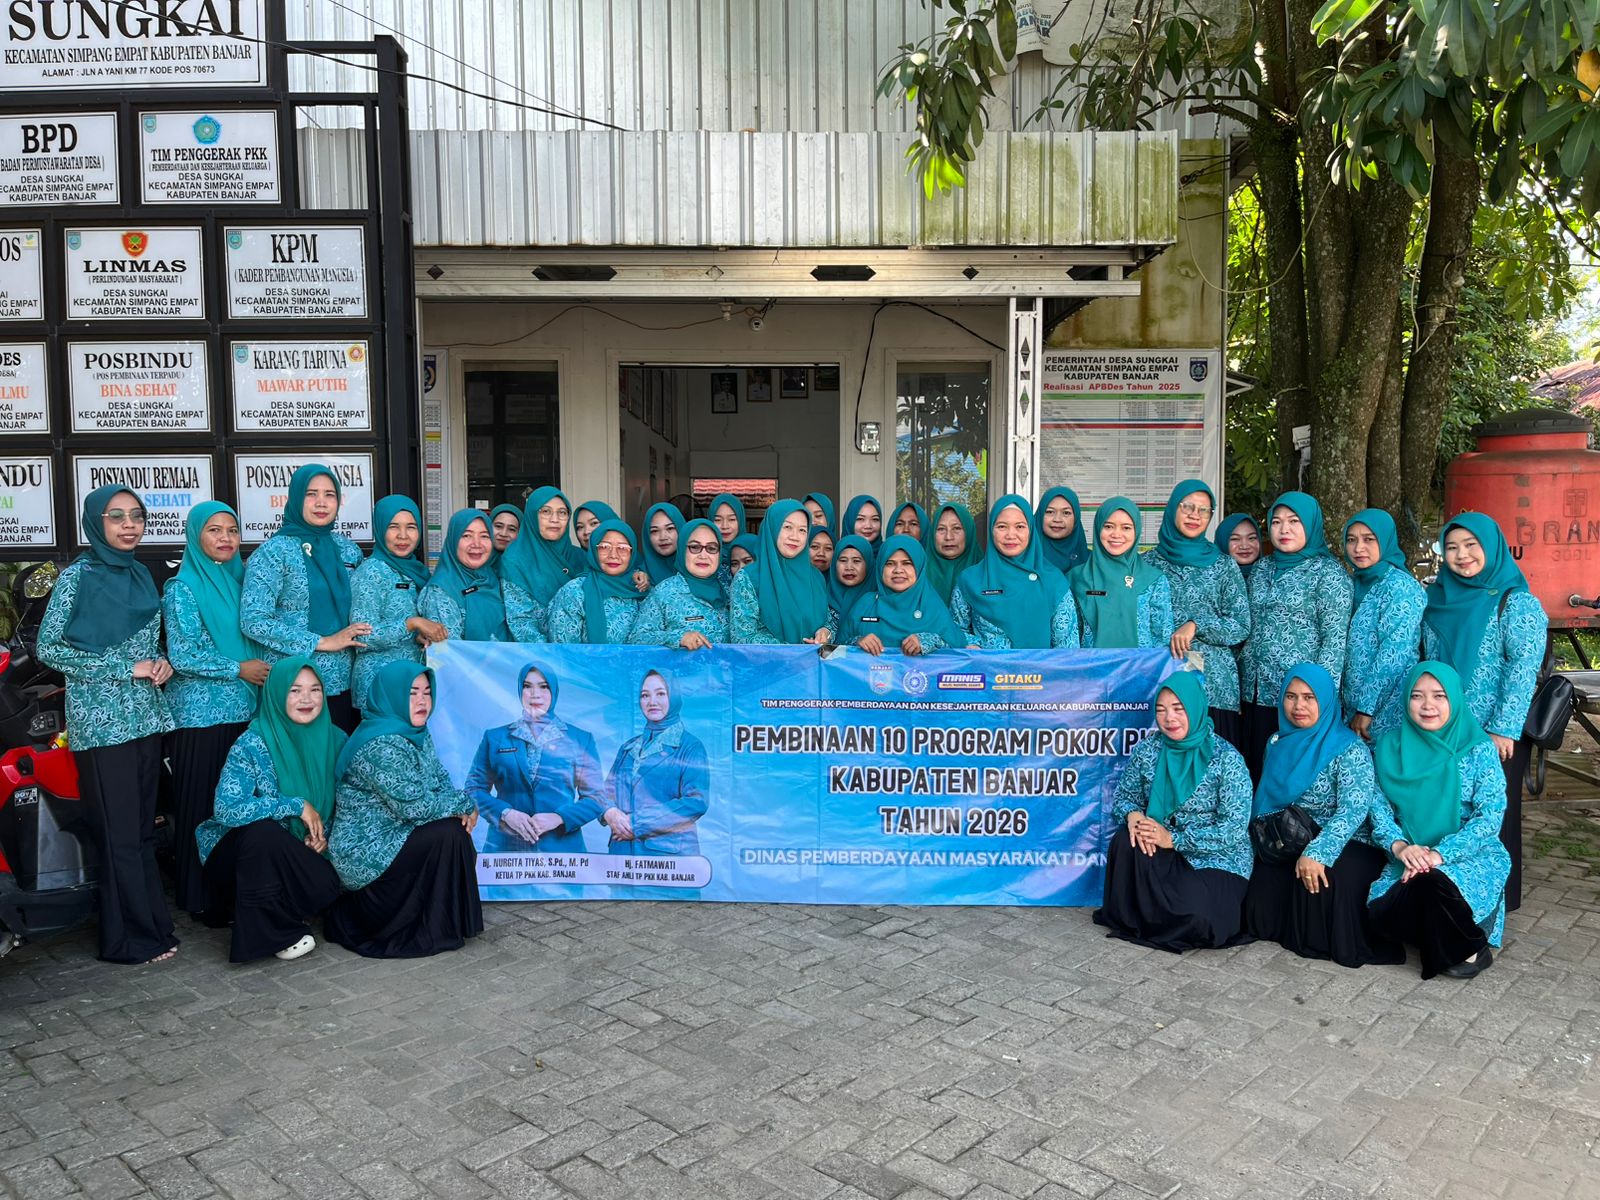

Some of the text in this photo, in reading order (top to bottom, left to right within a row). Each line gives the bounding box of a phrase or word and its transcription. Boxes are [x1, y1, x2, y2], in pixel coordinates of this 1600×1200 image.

[8, 0, 244, 41] SUNGKAI
[5, 44, 252, 65] KECAMATAN SIMPANG EMPAT KABUPATEN BANJAR
[42, 64, 216, 77] ALAMAT JLN A YANI KM 77 KODE POS 70673
[21, 124, 78, 153] BPD
[151, 147, 268, 161] TIM PENGGERAK PKK
[22, 156, 84, 171] PERMUSYAWARATAN
[21, 174, 84, 184] DESA SUNGKAI
[178, 172, 244, 181] DESA SUNGKAI
[45, 183, 114, 192] SIMPANG EMPAT
[148, 182, 274, 190] KECAMATAN SIMPANG EMPAT
[9, 192, 96, 202] KABUPATEN BANJAR
[166, 191, 257, 199] KABUPATEN BANJAR
[270, 234, 319, 263] KPM
[83, 260, 187, 273] LINMAS
[103, 289, 168, 297] DESA SUNGKAI
[265, 288, 330, 296] DESA SUNGKAI
[10, 300, 38, 308] EMPAT
[73, 298, 199, 306] KECAMATAN SIMPANG EMPAT
[235, 297, 289, 305] KECAMATAN
[291, 297, 330, 305] SIMPANG
[91, 307, 181, 315] KABUPATEN BANJAR
[253, 306, 344, 314] KABUPATEN BANJAR
[84, 352, 193, 370] POSBINDU
[253, 350, 347, 370] KARANG TARUNA
[110, 372, 149, 380] PEMBINAAN
[101, 383, 177, 398] BINA SEHAT
[257, 378, 348, 393] MAWAR PUTIH
[1089, 383, 1124, 391] APBDes
[108, 402, 173, 410] DESA SUNGKAI
[271, 401, 335, 409] DESA SUNGKAI
[15, 412, 43, 420] EMPAT
[78, 411, 132, 419] KECAMATAN
[133, 411, 173, 419] SIMPANG
[240, 410, 366, 418] KECAMATAN SIMPANG EMPAT
[259, 419, 348, 427] KABUPATEN BANJAR
[90, 467, 200, 489] POSYANDU REMAJA
[144, 493, 192, 507] SEHATI
[942, 674, 982, 682] MANIS
[994, 674, 1042, 684] GITAKU
[778, 700, 834, 708] PENGGERAK
[835, 701, 909, 710] PEMBERDAYAAN
[930, 703, 1009, 711] KESEJAHTERAAN
[1010, 703, 1058, 711] KELUARGA
[1059, 703, 1112, 711] KABUPATEN
[735, 725, 876, 754] PEMBINAAN
[883, 726, 906, 754] 10
[914, 726, 1030, 756] PROGRAM
[1037, 727, 1117, 757] POKOK
[830, 766, 1078, 796] KABUPATEN BANJAR
[880, 806, 1029, 837] TAHUN 2026
[493, 858, 523, 867] NURGITA
[580, 858, 589, 867] Pd
[744, 850, 797, 864] DINAS
[801, 850, 946, 865] PEMBERDAYAAN
[949, 852, 1071, 866] MASYARAKAT
[635, 860, 676, 870] FATMAWATI
[495, 871, 513, 879] KETUA
[516, 871, 522, 879] TP
[553, 870, 576, 878] BANJAR
[606, 871, 621, 879] STAF
[636, 872, 642, 880] TP
[671, 874, 695, 882] BANJAR
